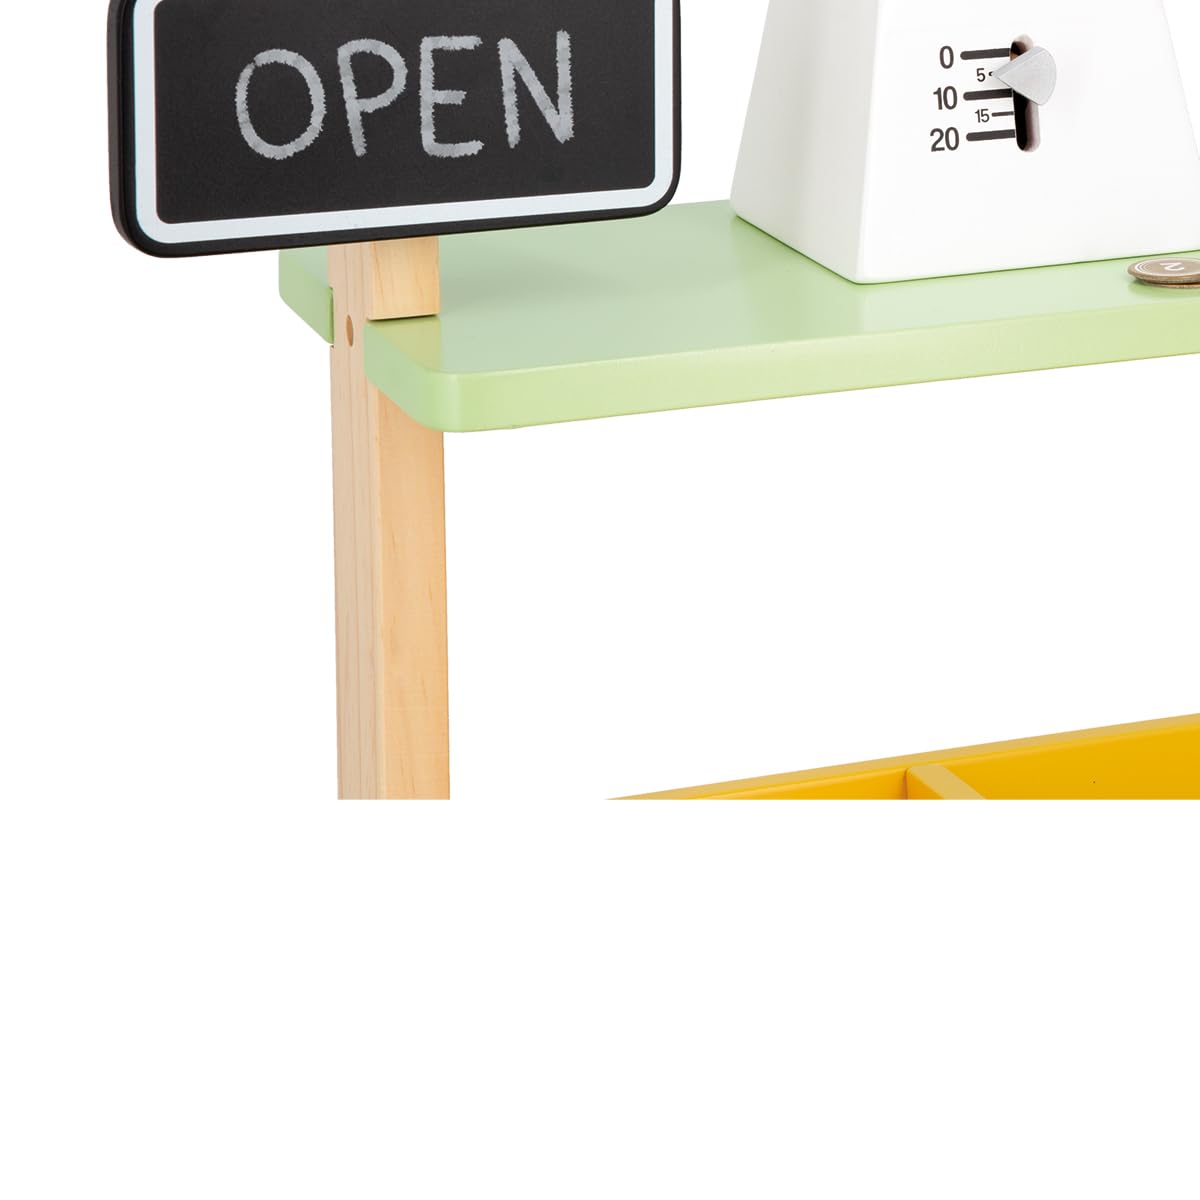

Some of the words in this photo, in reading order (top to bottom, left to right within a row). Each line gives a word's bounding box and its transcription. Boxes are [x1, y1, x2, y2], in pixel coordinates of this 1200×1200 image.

[939, 45, 954, 70] 0
[976, 67, 986, 83] 5
[235, 29, 575, 161] OPEN
[932, 85, 958, 110] 10
[974, 108, 990, 123] 15
[929, 126, 960, 152] 20
